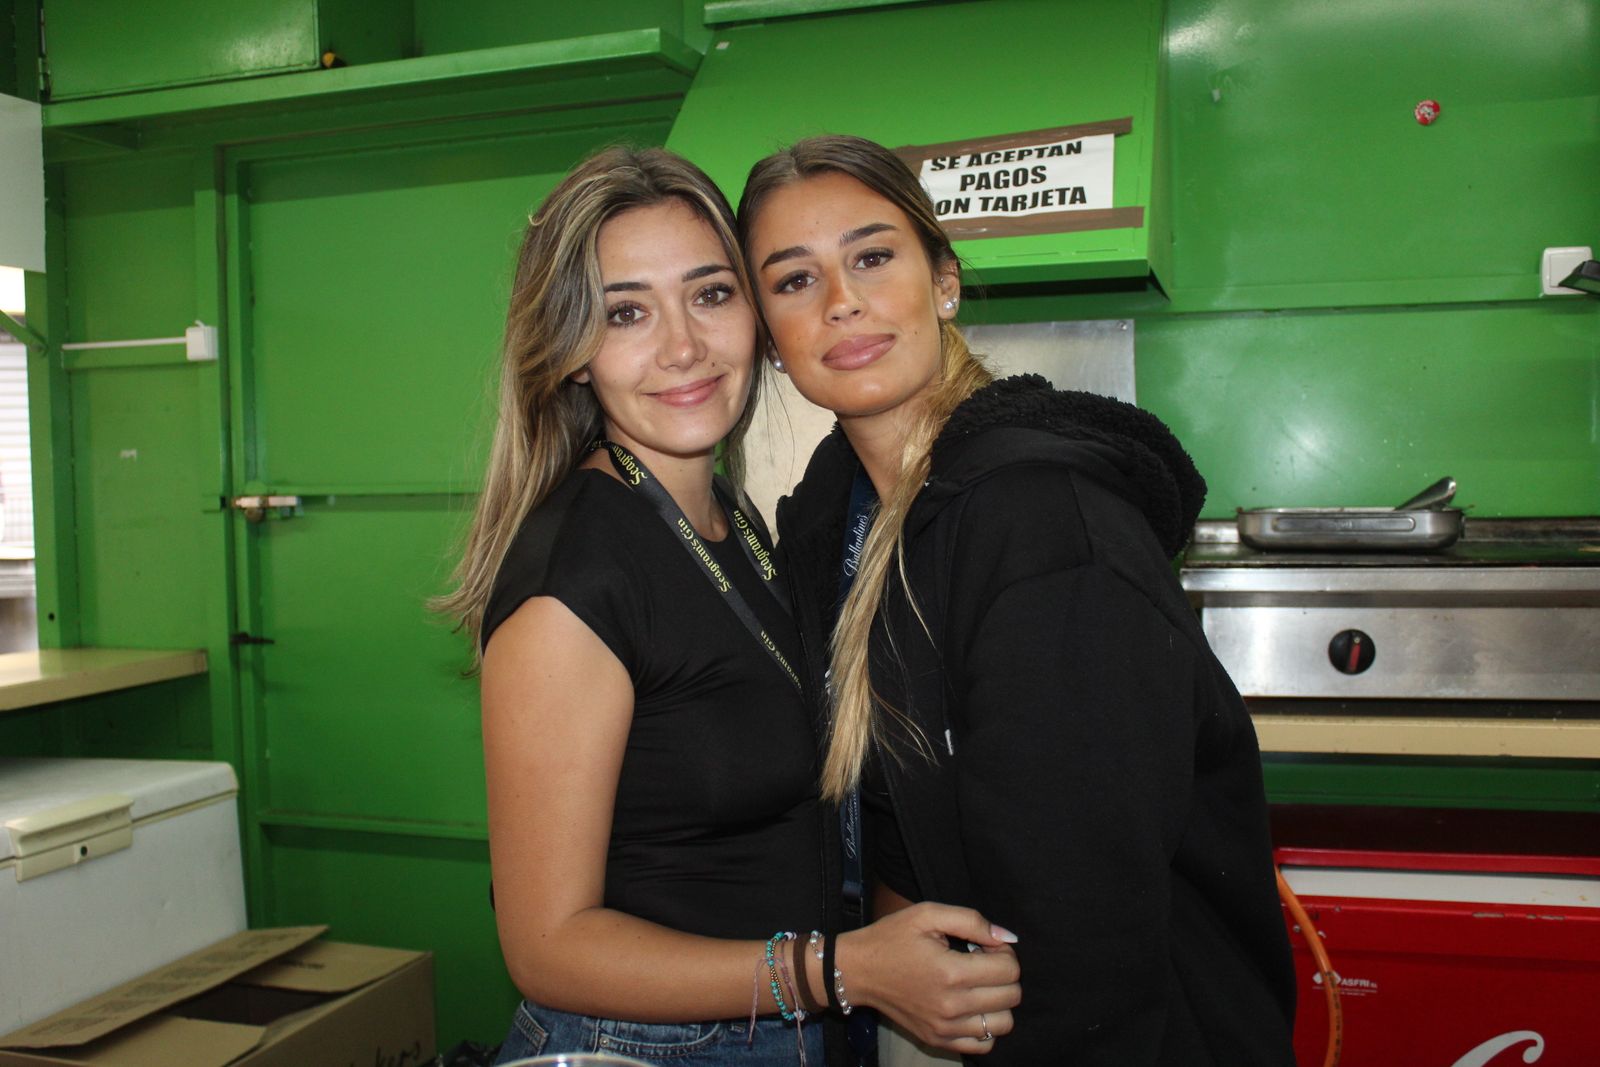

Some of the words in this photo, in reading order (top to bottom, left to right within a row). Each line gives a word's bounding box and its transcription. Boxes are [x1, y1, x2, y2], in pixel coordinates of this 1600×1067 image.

[930, 156, 960, 171] SE
[967, 141, 1082, 164] ACEPTAN
[960, 165, 1047, 191] PAGOS
[935, 198, 971, 216] ON
[978, 186, 1087, 212] TARJETA
[677, 518, 694, 540] Gin
[733, 509, 748, 530] Gin
[691, 536, 733, 593] Seagram's
[746, 528, 777, 582] Seagram's
[760, 629, 776, 652] Gin
